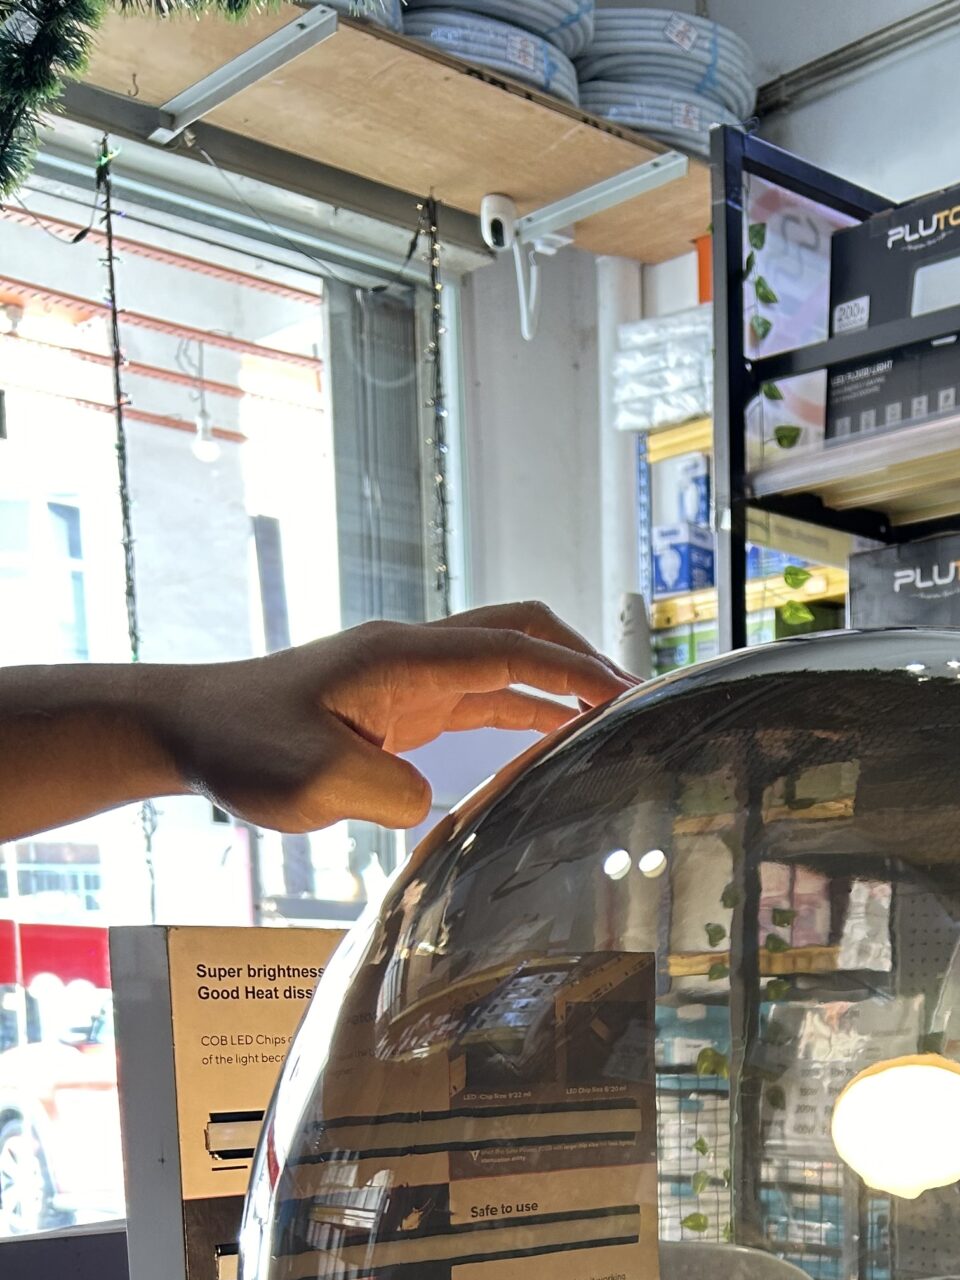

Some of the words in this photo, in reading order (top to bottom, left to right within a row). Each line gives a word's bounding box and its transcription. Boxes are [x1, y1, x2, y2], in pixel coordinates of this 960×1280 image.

[196, 963, 242, 981] Super
[197, 986, 240, 1001] Good
[245, 986, 279, 1000] Heat
[283, 985, 317, 1000] diss
[201, 1034, 228, 1047] COB
[230, 1034, 254, 1046] LED
[256, 1033, 286, 1048] Chips
[201, 1054, 215, 1066] of
[215, 1053, 233, 1065] the
[235, 1052, 259, 1066] light
[471, 1204, 498, 1219] Safe
[501, 1203, 513, 1215] to
[516, 1202, 539, 1213] use
